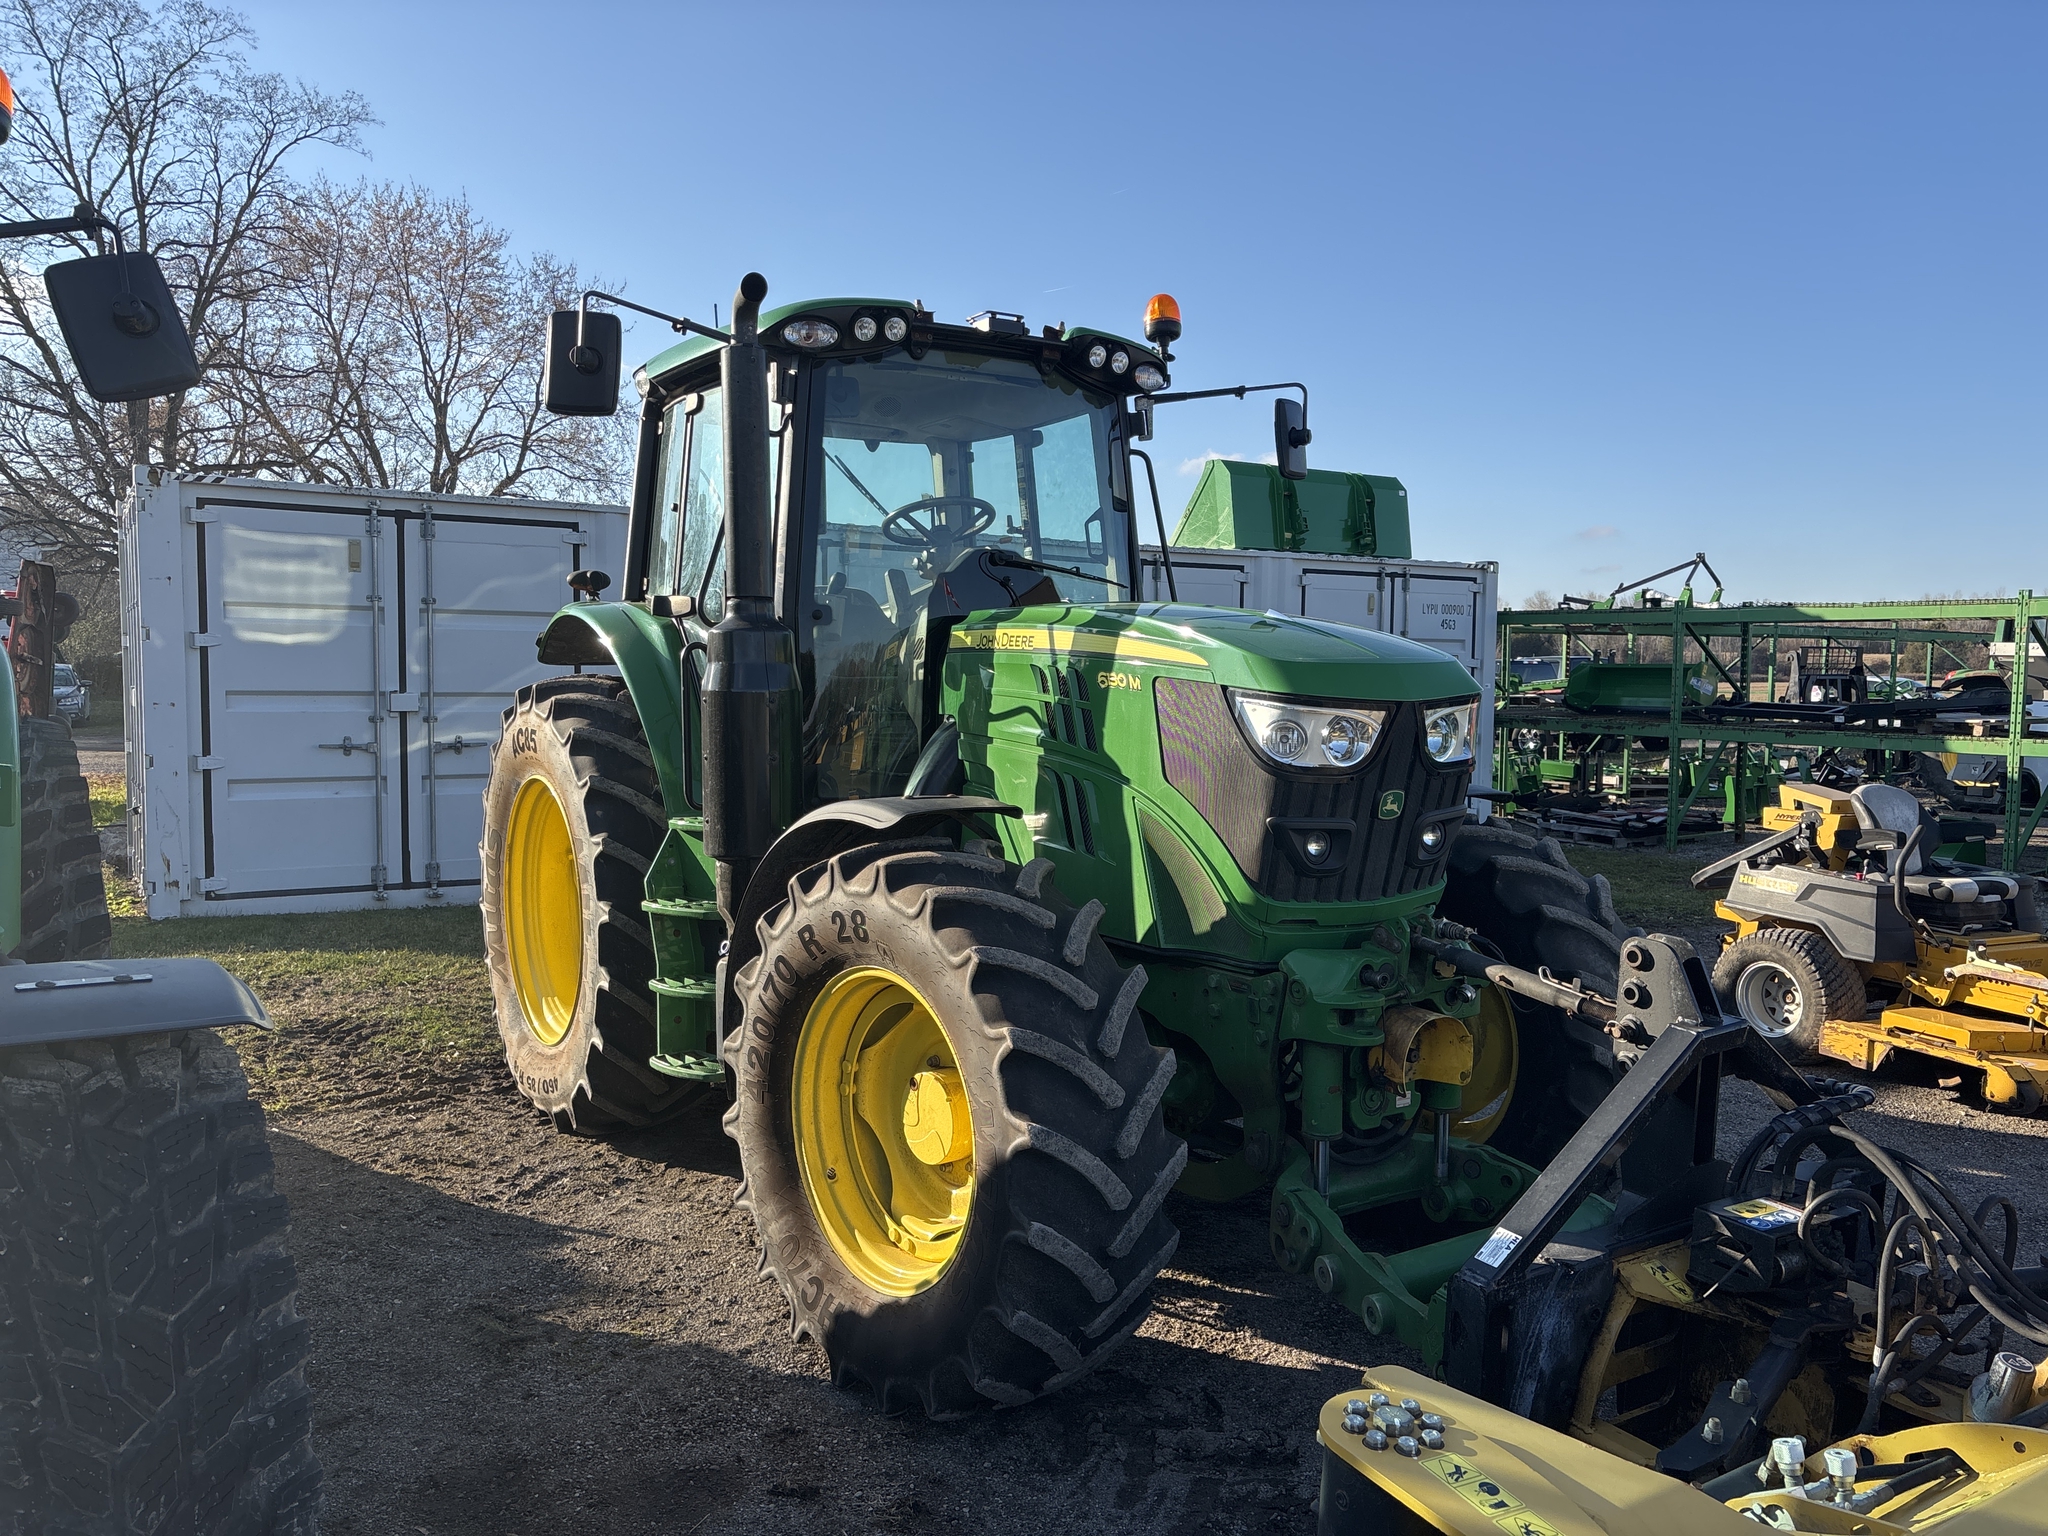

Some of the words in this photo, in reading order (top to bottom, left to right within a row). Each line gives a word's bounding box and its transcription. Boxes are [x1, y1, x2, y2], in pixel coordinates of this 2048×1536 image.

[1422, 603, 1438, 615] LYPU
[1441, 603, 1464, 615] 000900
[1440, 619, 1456, 630] 45G3
[976, 633, 1000, 648] JOHN
[1001, 632, 1034, 649] DEERE
[1097, 671, 1127, 689] 6130
[1128, 673, 1142, 691] M
[512, 727, 538, 758] AC85
[745, 954, 797, 1104] 420/70
[797, 924, 827, 961] R
[831, 909, 869, 944] 28
[526, 1076, 559, 1095] 460/85
[1504, 1236, 1520, 1250] HLA
